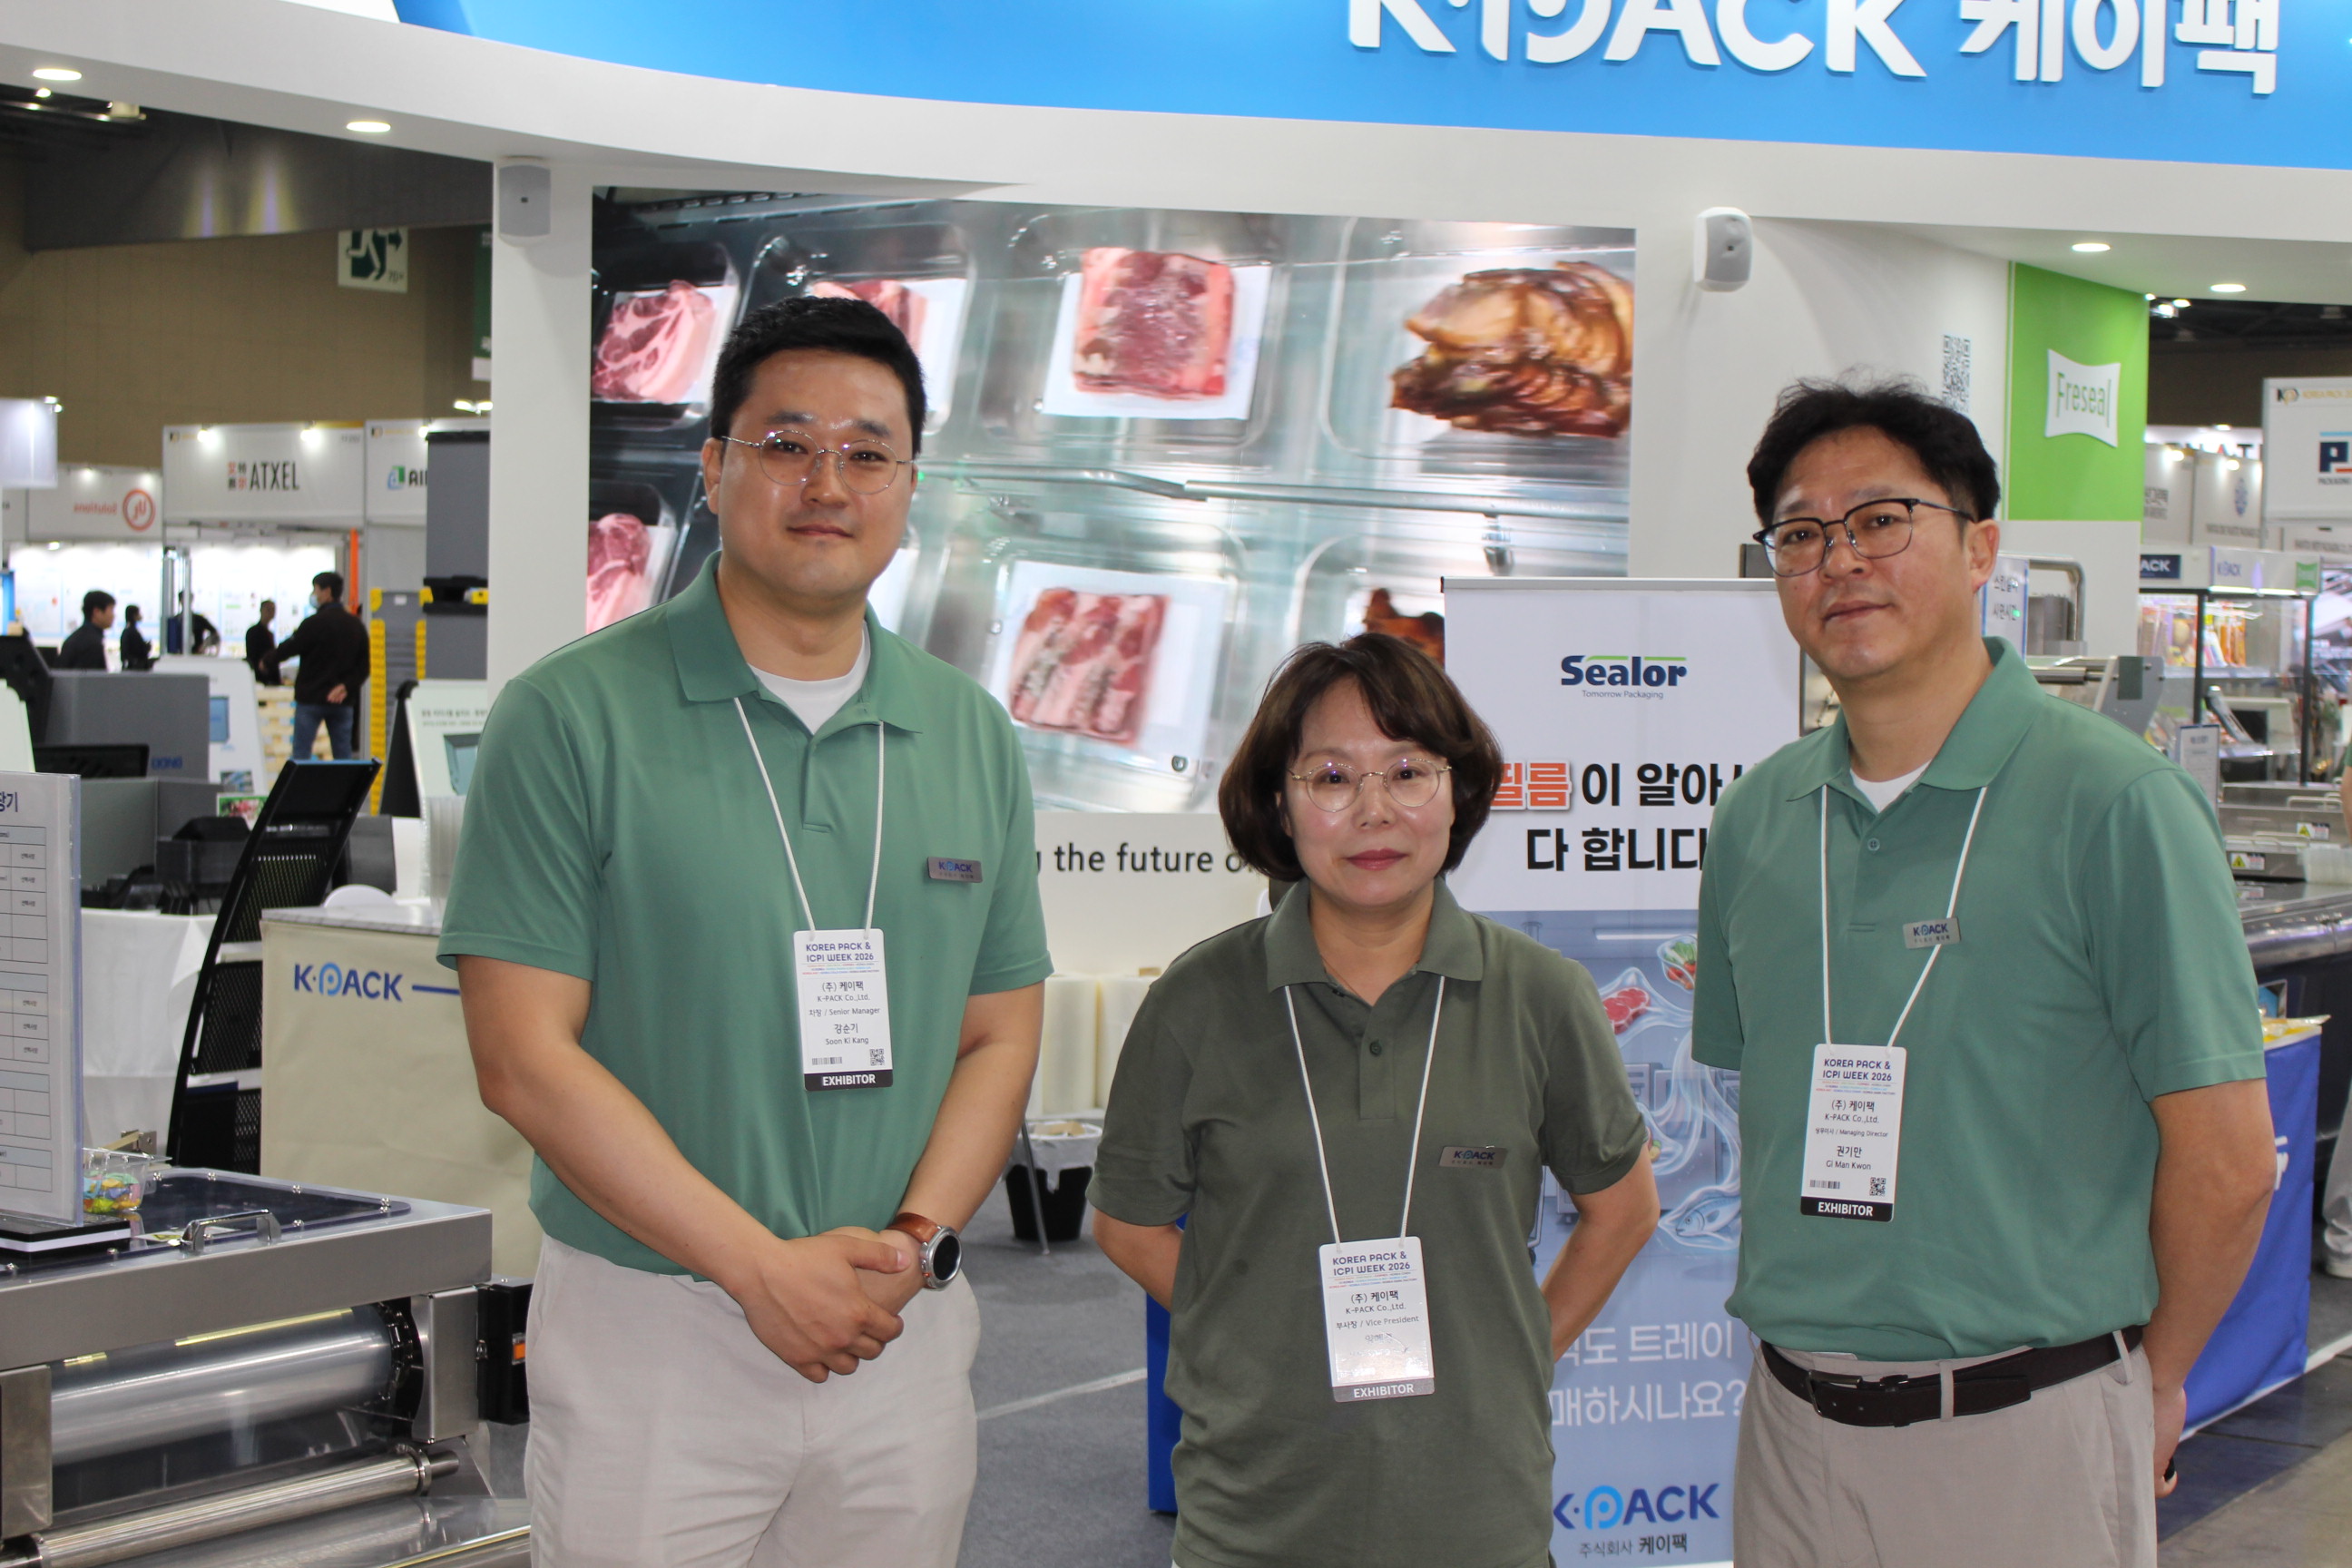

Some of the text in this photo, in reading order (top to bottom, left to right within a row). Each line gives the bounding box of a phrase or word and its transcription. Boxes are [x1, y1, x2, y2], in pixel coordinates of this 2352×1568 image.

[2056, 372, 2112, 427] Freseal
[250, 461, 299, 491] ATXEL
[1561, 655, 1687, 687] Sealor
[1583, 690, 1663, 700] Tomorrow Packaging
[1637, 763, 1743, 806] 알아
[1527, 828, 1708, 871] 다 합니다
[1054, 842, 1105, 871] the
[1117, 842, 1213, 872] future
[806, 943, 835, 952] KOREA
[838, 942, 862, 950] PACK
[807, 953, 874, 962] ICPI WEEK 2026
[822, 981, 864, 992] (주) 케이팩
[852, 1007, 880, 1016] Manager
[834, 1024, 858, 1034] 강순기
[1824, 1058, 1890, 1070] KOREA PACK &
[822, 1073, 876, 1086] EXHIBITOR
[1822, 1070, 1892, 1081] ICPI WEEK 2026
[1831, 1100, 1875, 1112] (주) 케이팩
[1825, 1113, 1850, 1122] K-PACK
[1839, 1129, 1865, 1137] Managing
[1837, 1145, 1862, 1158] 권기만
[1835, 1161, 1850, 1169] Man
[1852, 1161, 1871, 1170] Kwon
[1818, 1201, 1874, 1217] EXHIBITOR
[1332, 1251, 1407, 1265] KOREA PACK &
[1334, 1262, 1410, 1276] ICPI WEEK 2026
[1350, 1290, 1398, 1304] (주) 케이팩
[1346, 1304, 1375, 1314] K-PACK
[1336, 1320, 1357, 1329] 부사장
[1366, 1318, 1382, 1327] Vice
[1384, 1316, 1419, 1324] President
[1629, 1320, 1732, 1361] 트레이
[1353, 1383, 1414, 1398] EXHIBITOR
[1579, 1533, 1688, 1559] 주식회사 케이팩
